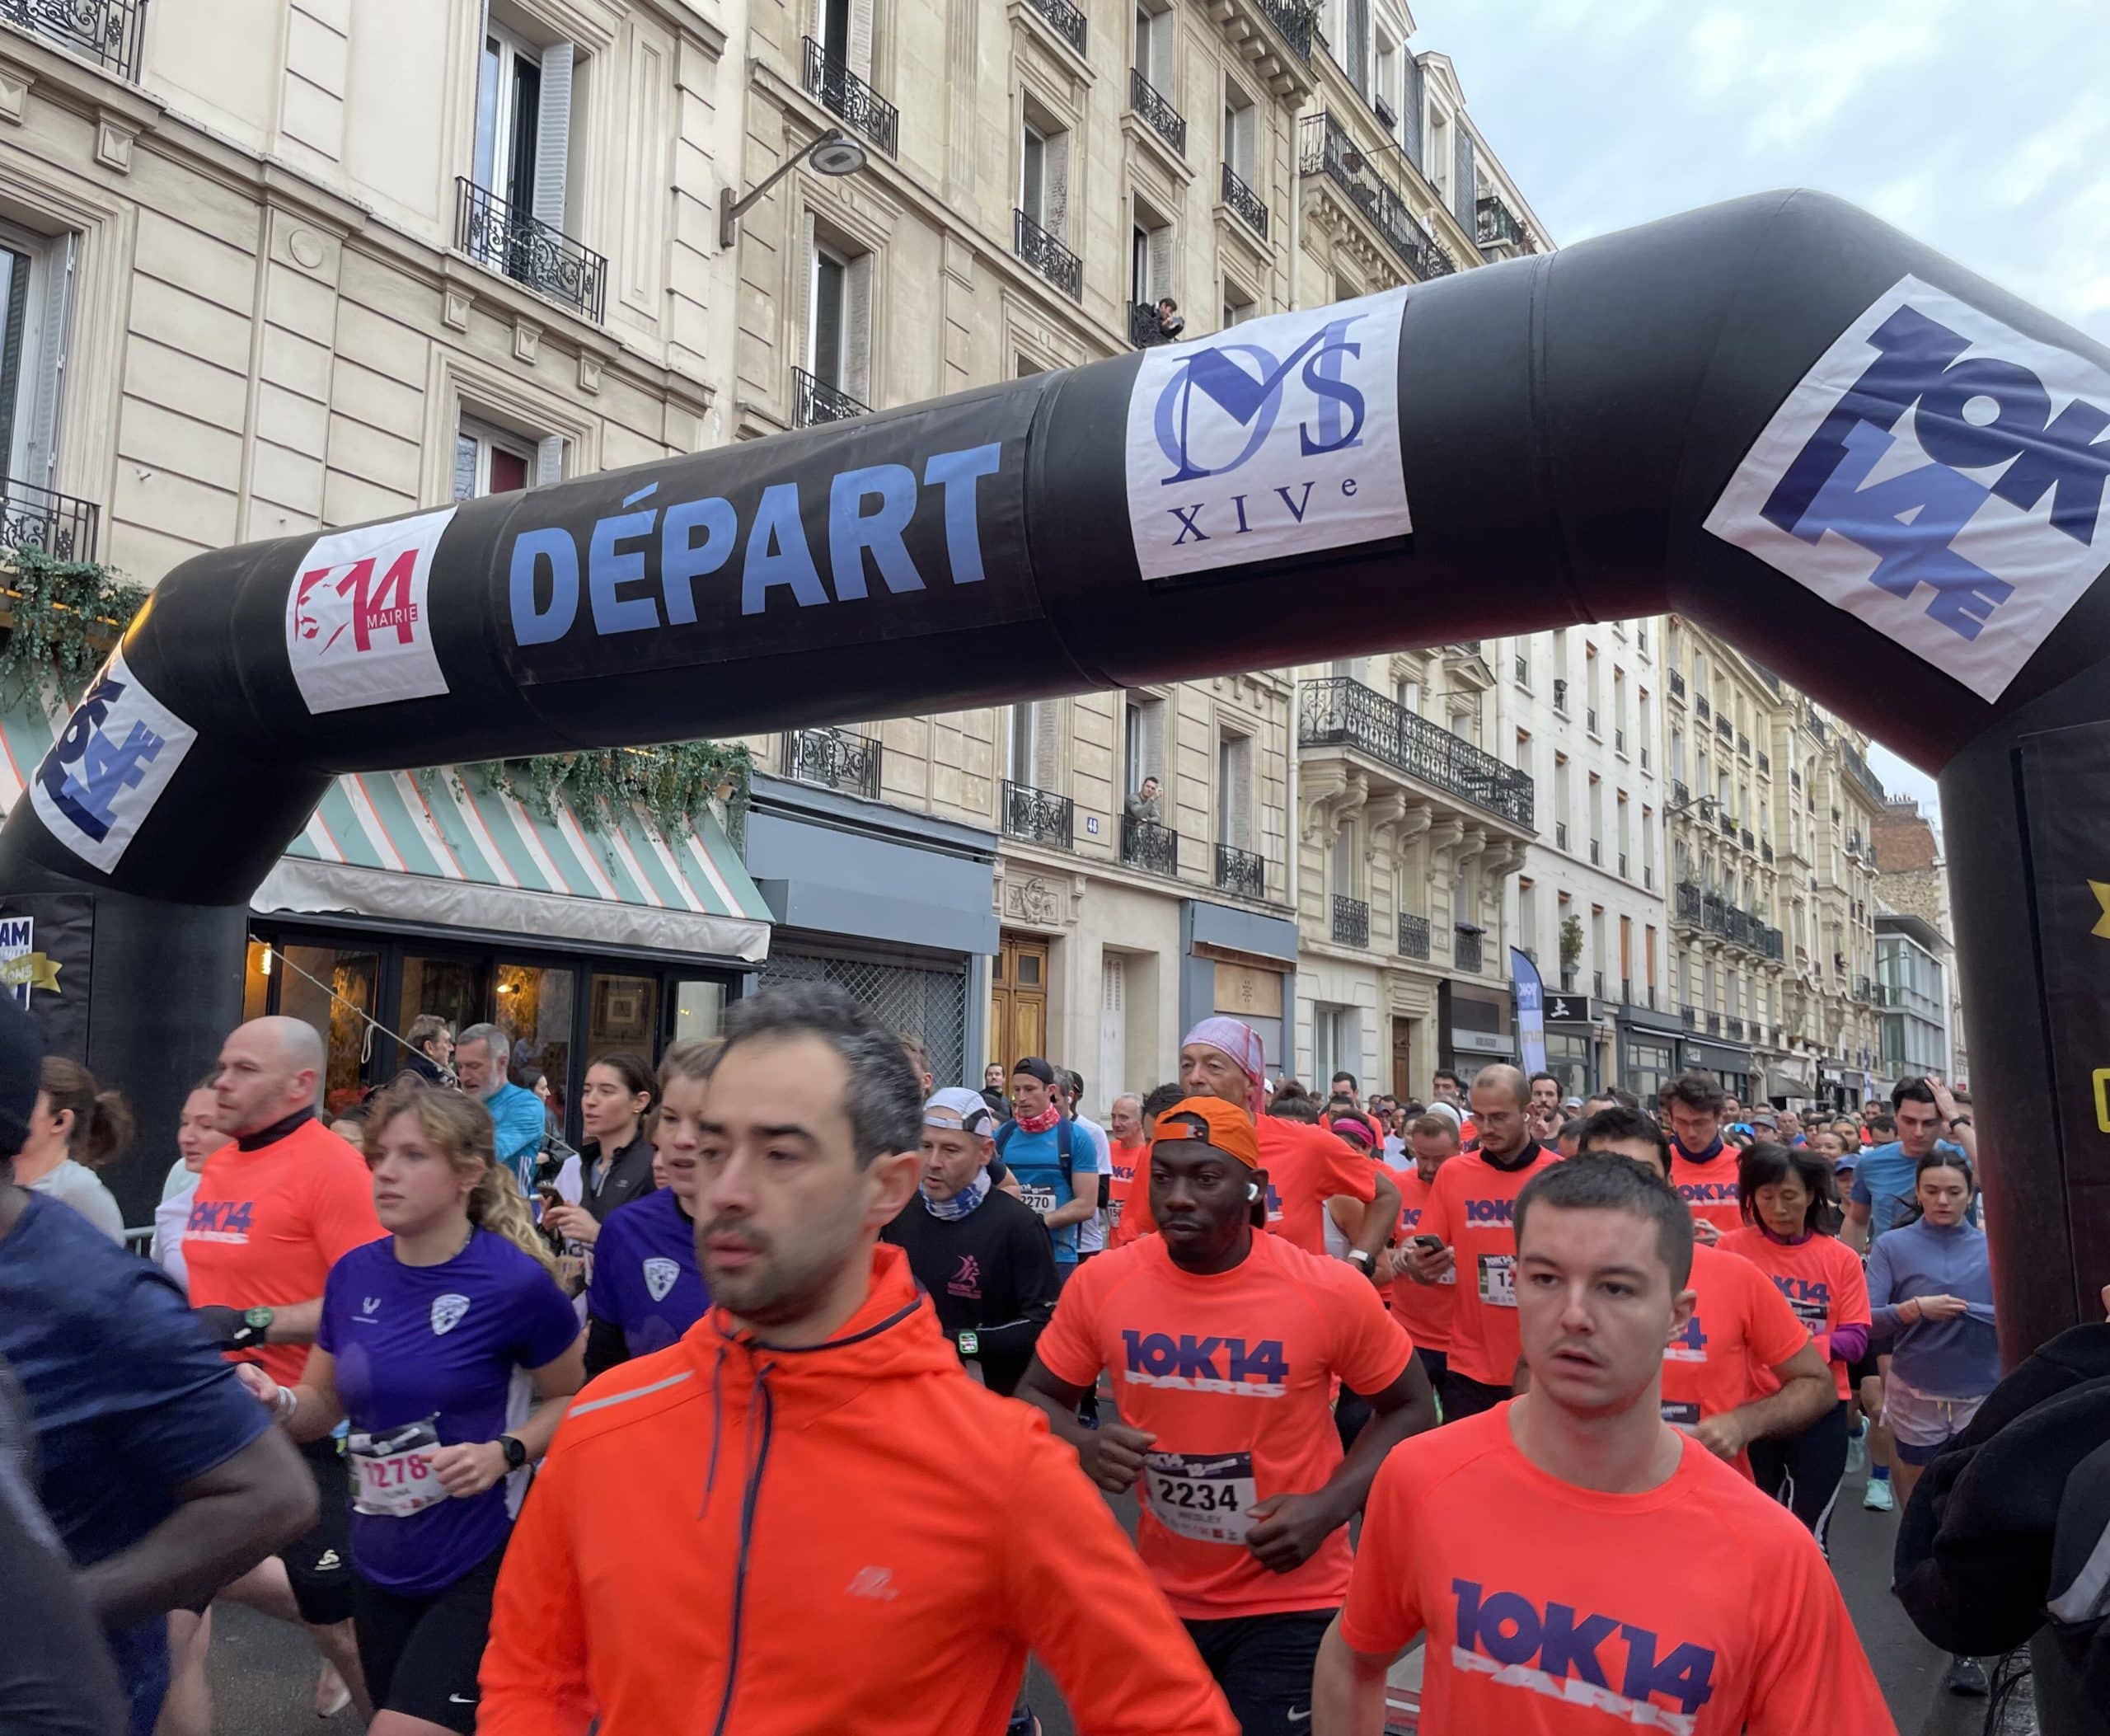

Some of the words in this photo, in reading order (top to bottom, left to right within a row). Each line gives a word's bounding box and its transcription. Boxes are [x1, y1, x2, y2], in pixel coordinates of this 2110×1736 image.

[509, 441, 1001, 647] DÉPART
[366, 604, 418, 630] MAIRIE
[1088, 818, 1097, 833] 48
[1122, 1330, 1290, 1385] 10K14
[1123, 1369, 1287, 1399] PARIS
[364, 1454, 429, 1489] 1278
[1157, 1478, 1239, 1513] 2234
[1451, 1577, 1716, 1715] 10K14
